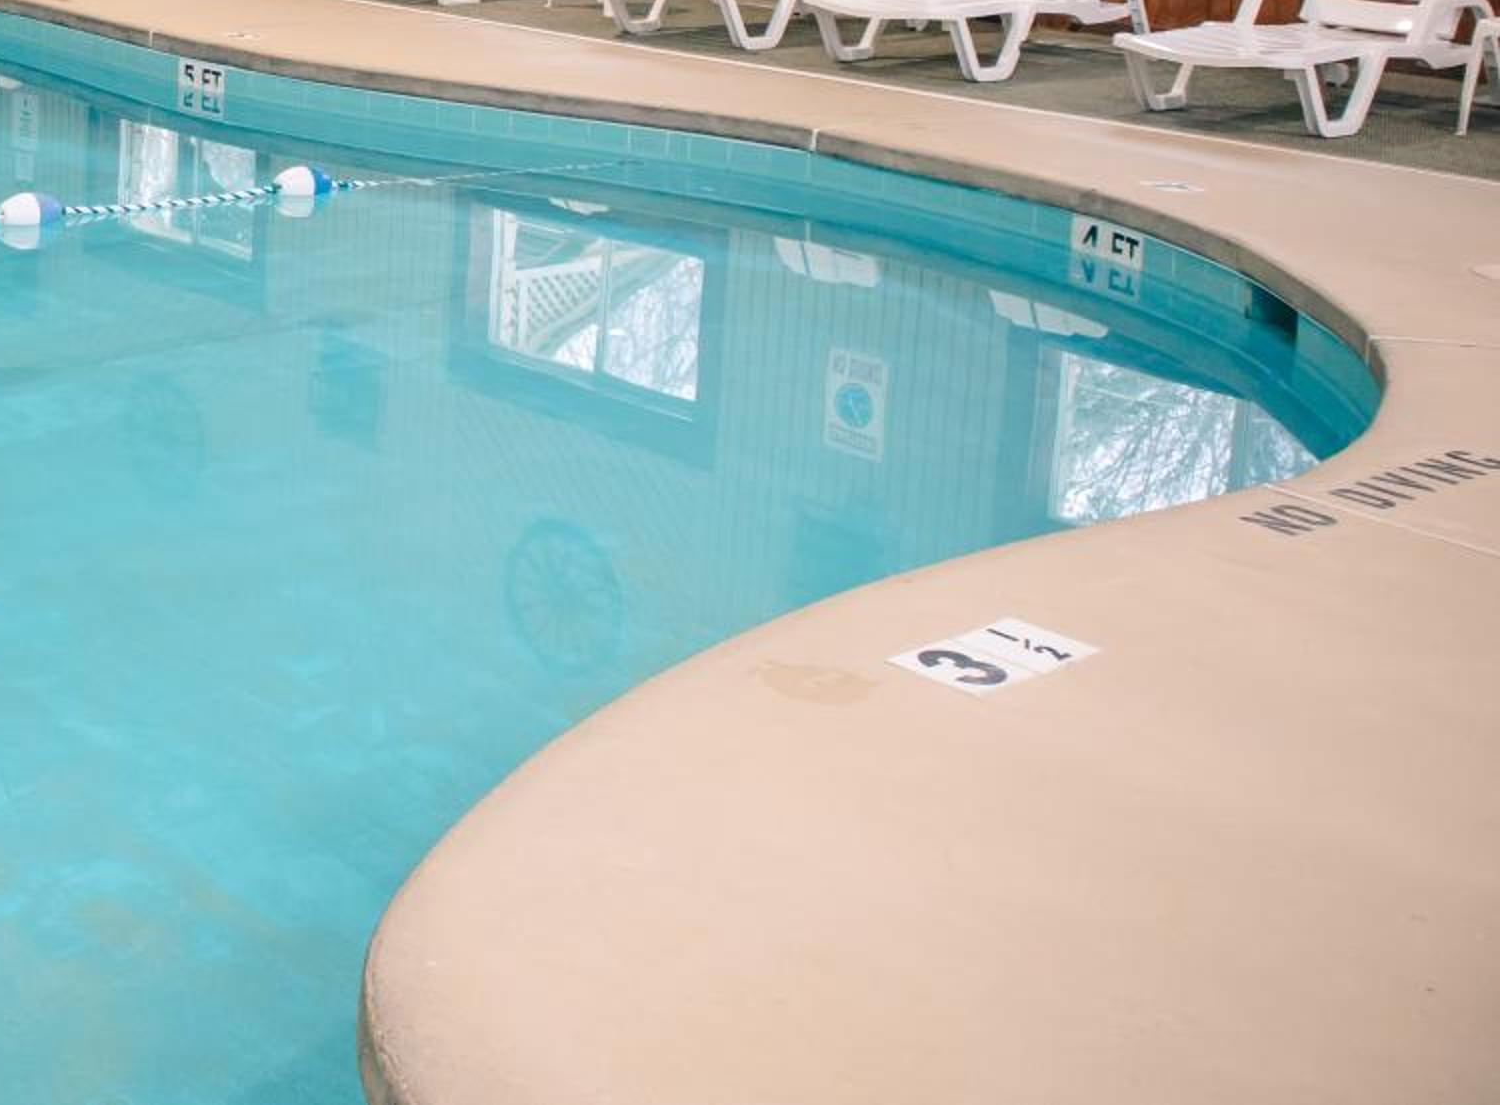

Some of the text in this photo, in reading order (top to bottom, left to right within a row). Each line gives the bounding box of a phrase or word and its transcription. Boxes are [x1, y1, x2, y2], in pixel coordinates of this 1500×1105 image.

[1238, 450, 1500, 537] NO DIVING
[917, 649, 1008, 686] 3
